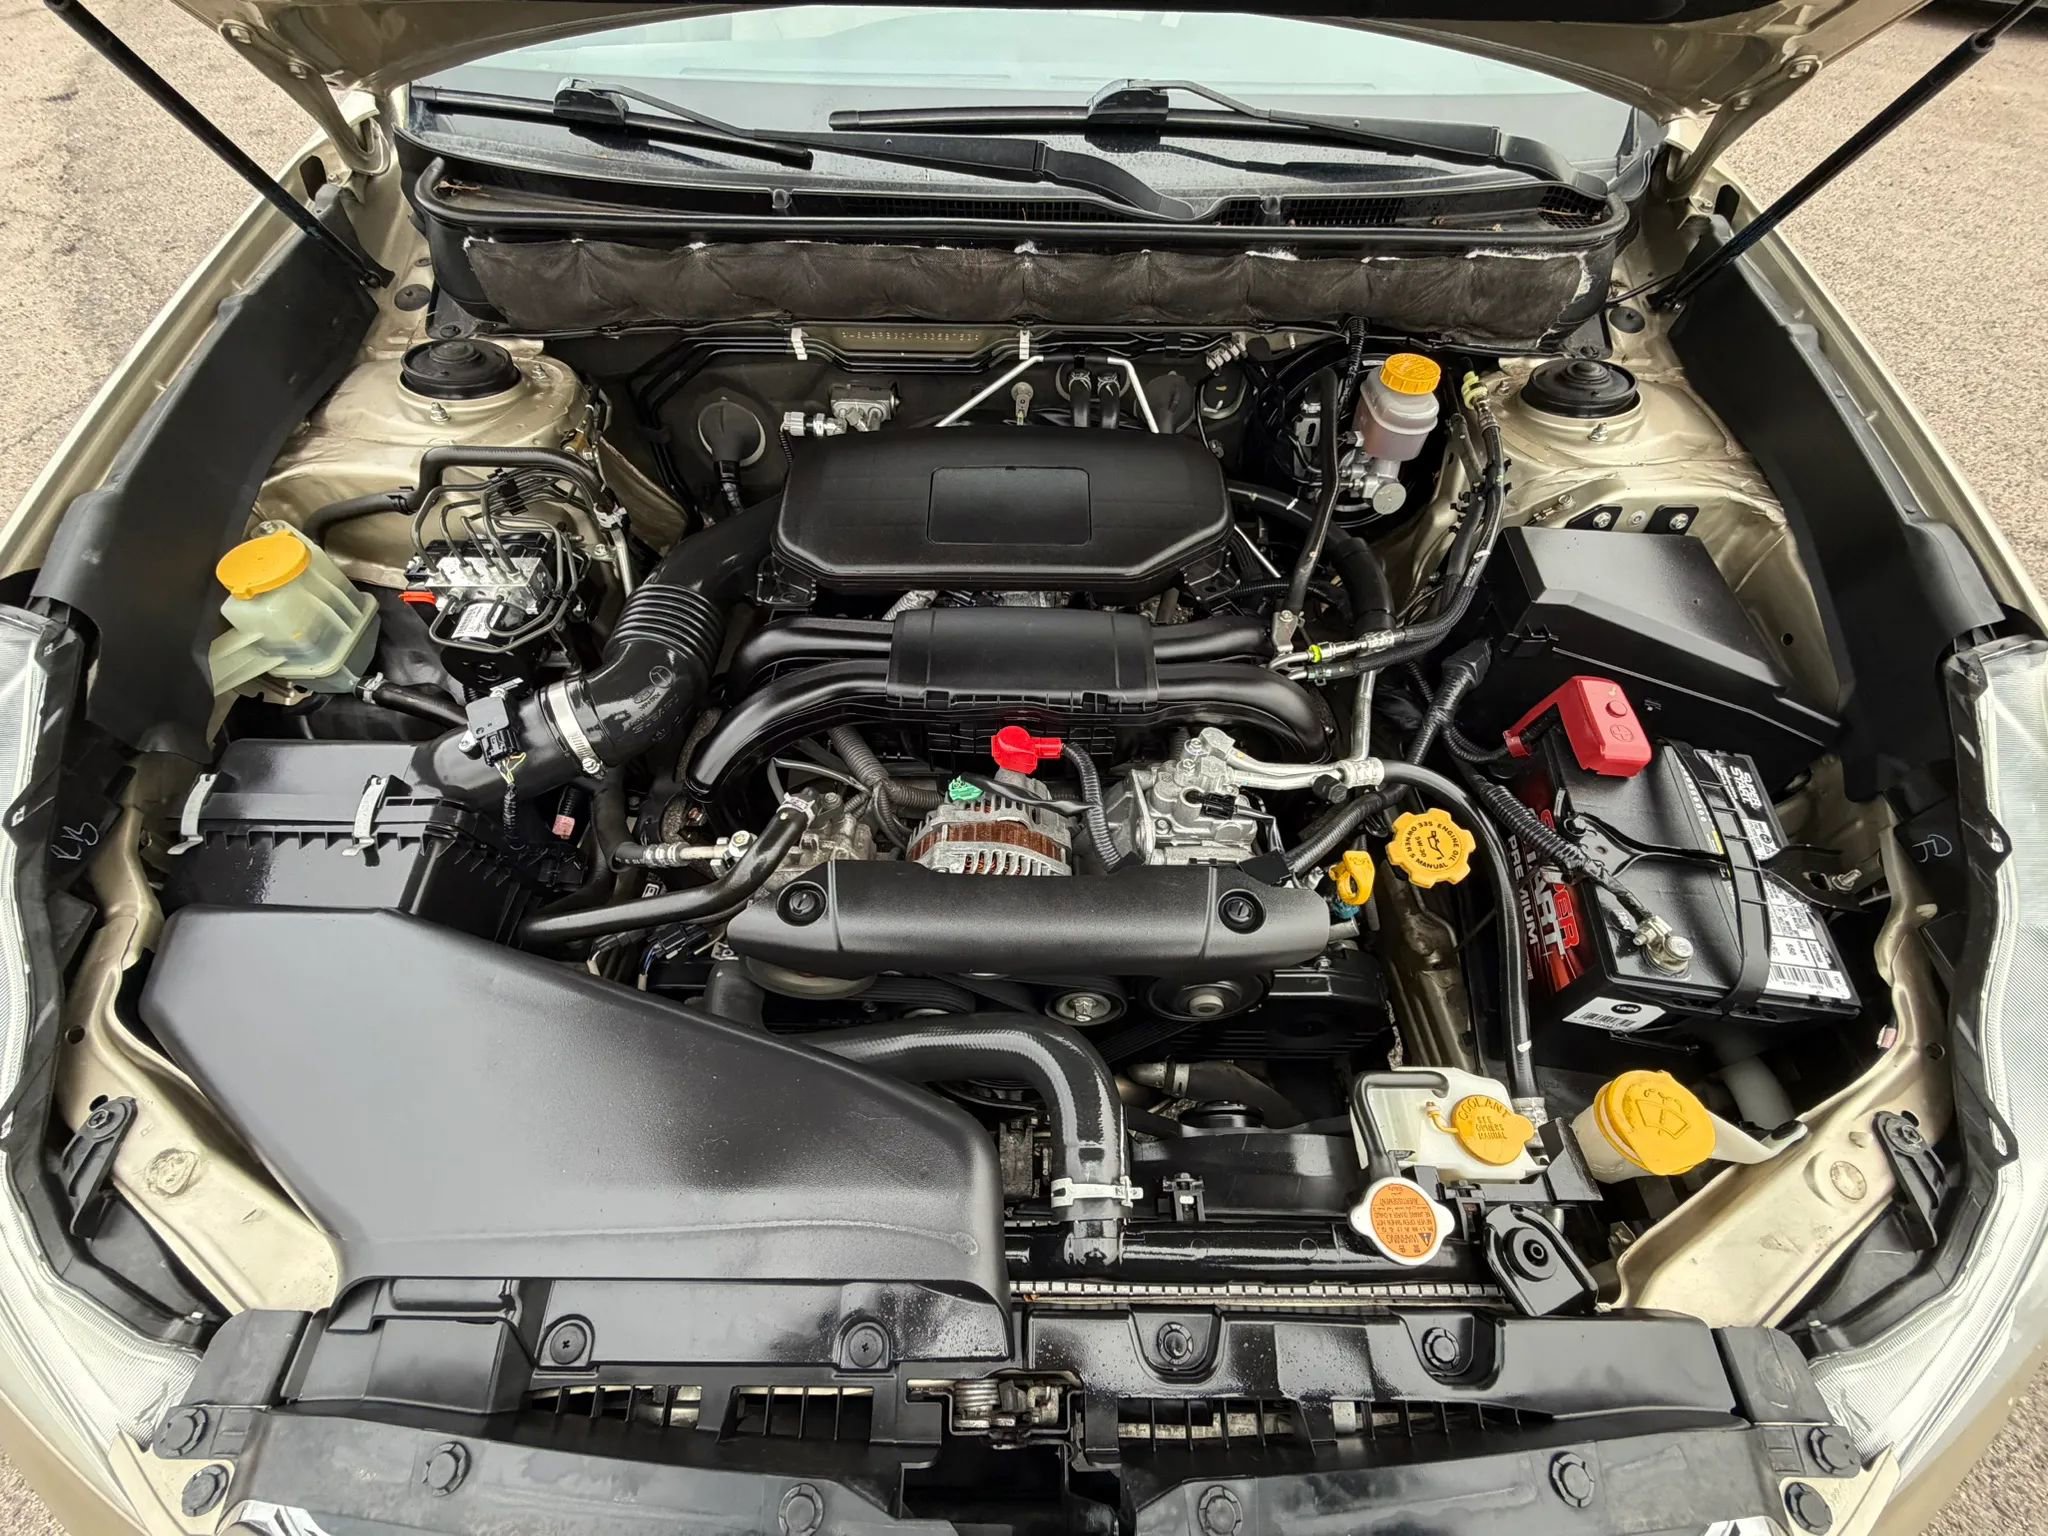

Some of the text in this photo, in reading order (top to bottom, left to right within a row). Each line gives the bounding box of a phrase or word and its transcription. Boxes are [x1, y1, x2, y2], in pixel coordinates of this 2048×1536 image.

[1730, 765, 1751, 804] START
[1743, 771, 1762, 810] SUPER
[1437, 823, 1459, 862] ENGINE OIL
[1415, 858, 1449, 869] MANUAL
[1458, 1097, 1512, 1121] COOLANT
[1385, 1234, 1419, 1244] WARNING
